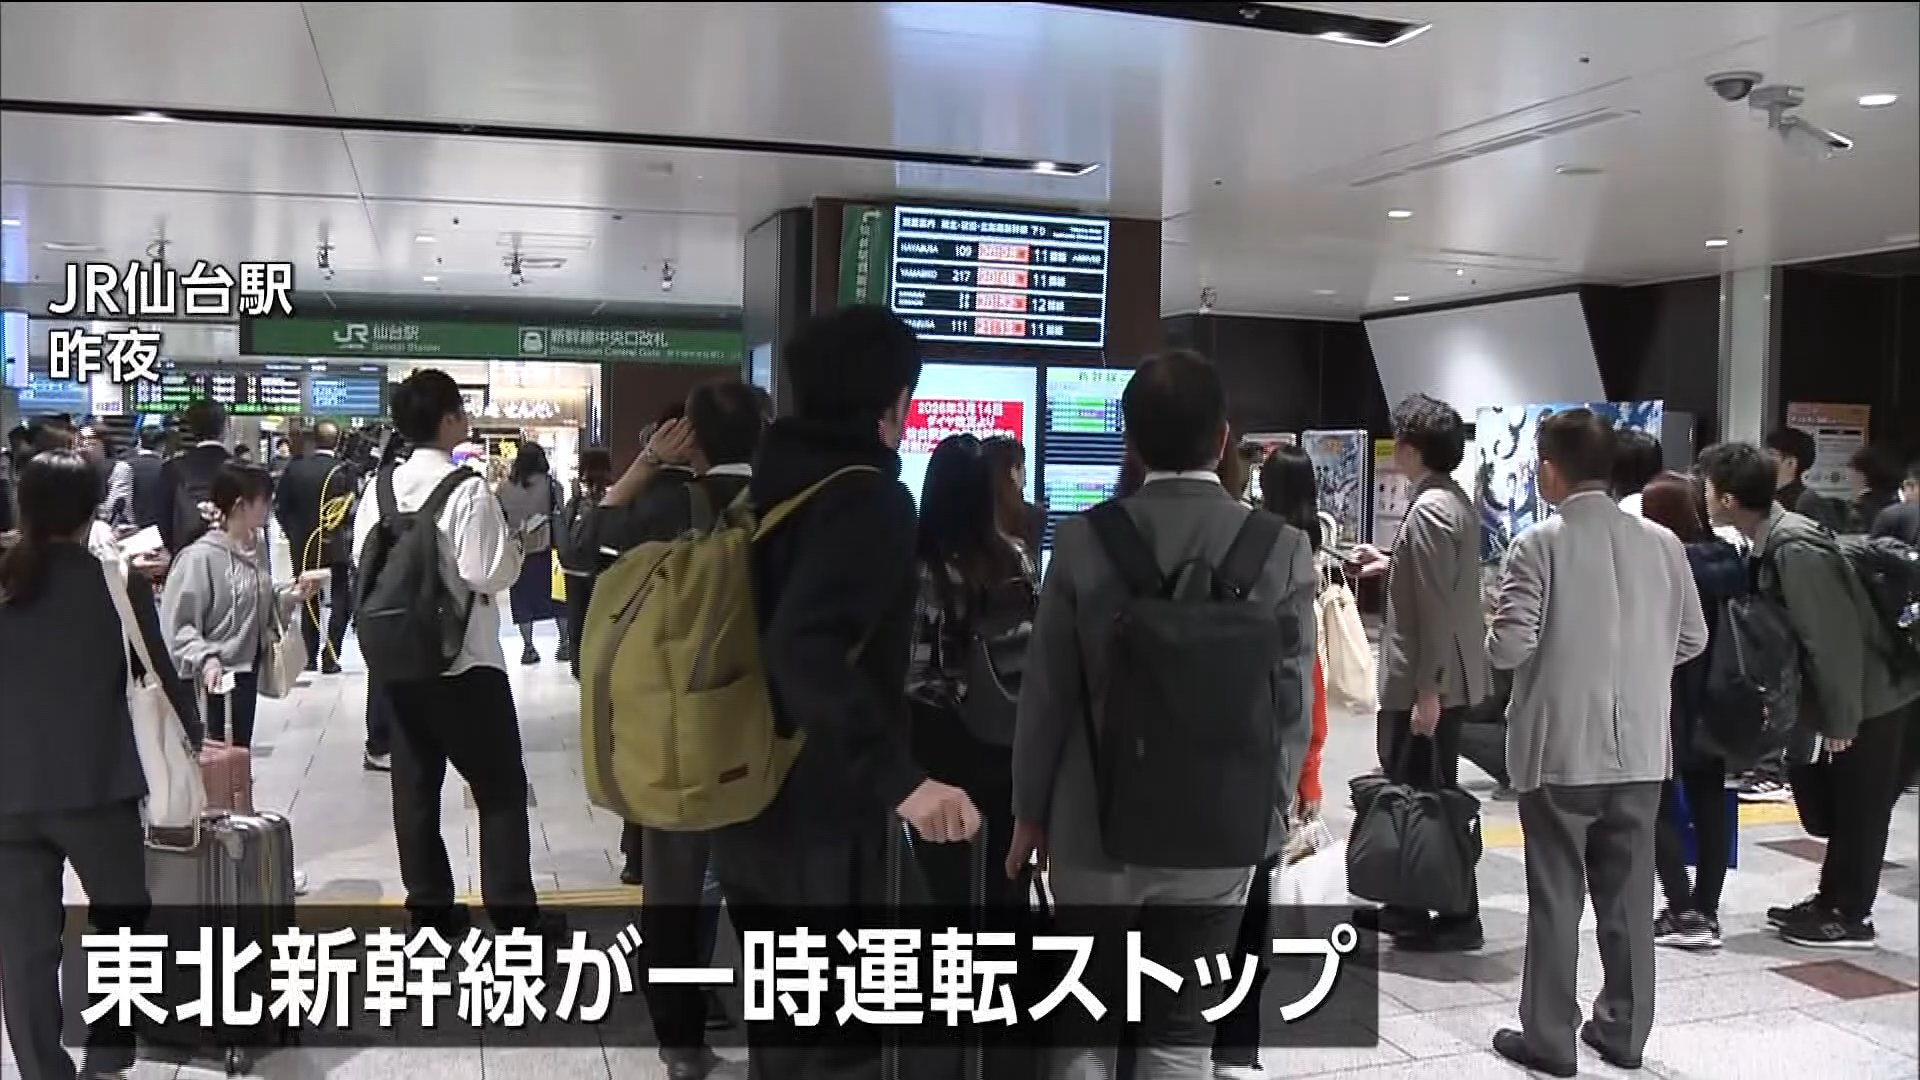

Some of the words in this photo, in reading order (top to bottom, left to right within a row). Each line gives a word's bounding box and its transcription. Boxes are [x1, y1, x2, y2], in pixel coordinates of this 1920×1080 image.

[955, 245, 972, 257] 109
[952, 270, 971, 282] 217
[333, 323, 369, 343] JR
[373, 323, 419, 341] 仙台駅
[951, 320, 968, 332] 111
[551, 328, 669, 348] 新幹線中央口改札
